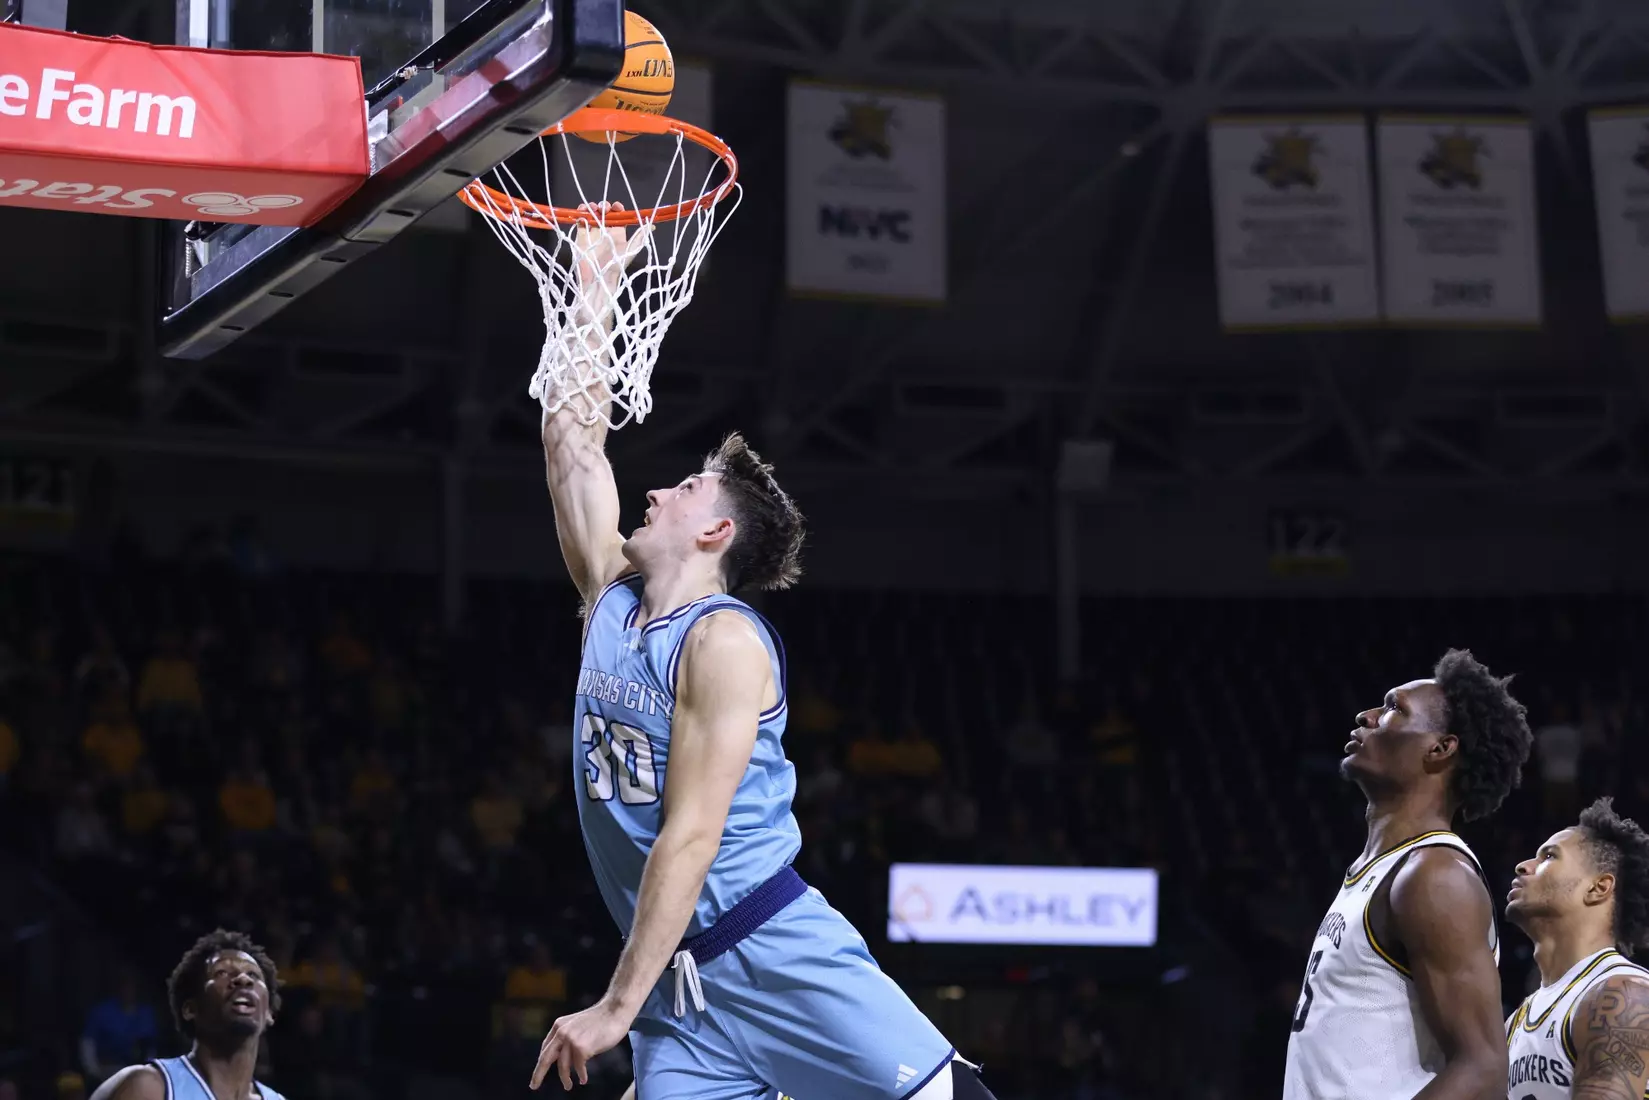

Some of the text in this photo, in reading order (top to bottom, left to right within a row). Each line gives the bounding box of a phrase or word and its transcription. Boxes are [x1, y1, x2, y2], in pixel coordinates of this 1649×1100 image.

[36, 67, 196, 139] Farm
[0, 178, 177, 209] Stat
[622, 680, 673, 719] CITY
[581, 712, 660, 806] 30
[948, 886, 1147, 926] ASHLEY
